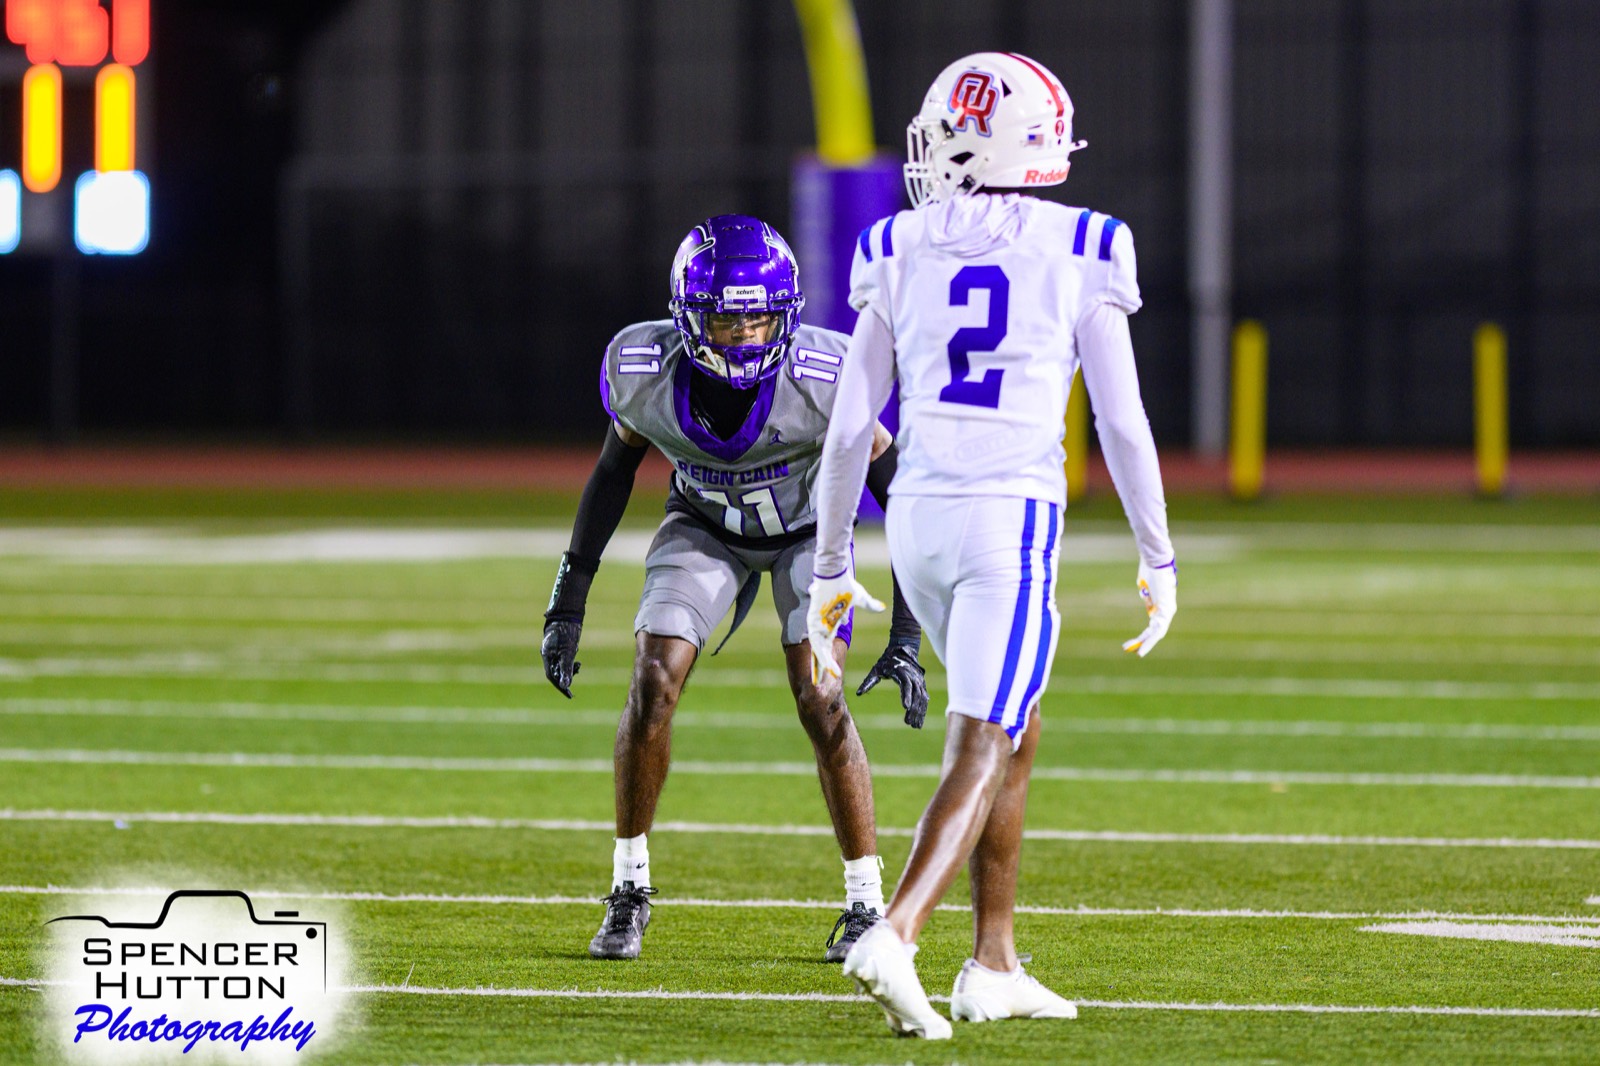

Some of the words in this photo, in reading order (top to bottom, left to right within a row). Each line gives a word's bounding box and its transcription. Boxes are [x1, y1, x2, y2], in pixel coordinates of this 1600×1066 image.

[939, 265, 1009, 409] 2
[618, 343, 662, 375] 11
[792, 347, 842, 384] 11
[677, 459, 734, 487] REIGN
[740, 460, 789, 485] CAIN
[697, 485, 790, 538] 11
